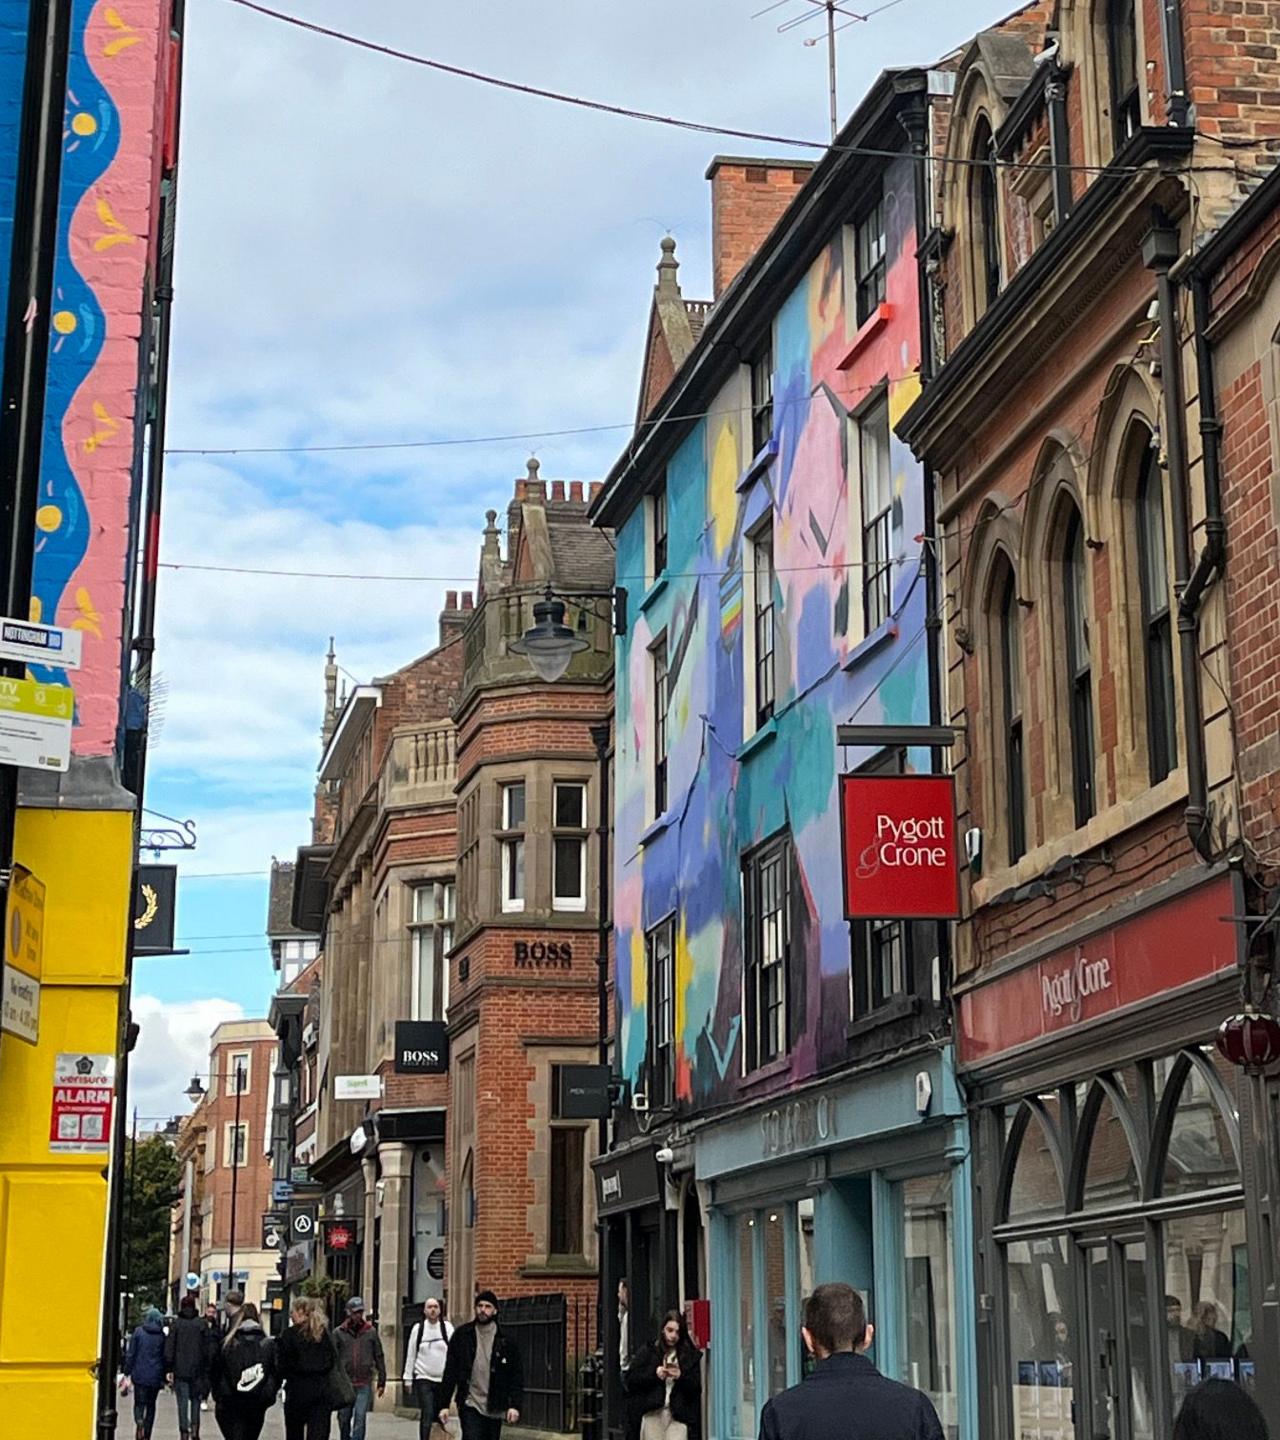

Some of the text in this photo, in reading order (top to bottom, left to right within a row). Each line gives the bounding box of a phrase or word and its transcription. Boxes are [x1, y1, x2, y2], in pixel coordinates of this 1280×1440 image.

[877, 814, 946, 844] Pygott
[880, 841, 947, 867] Crone
[514, 940, 573, 961] BOSS
[402, 1049, 439, 1063] BOSS
[59, 1075, 108, 1084] verisure
[55, 1088, 111, 1104] ALARM
